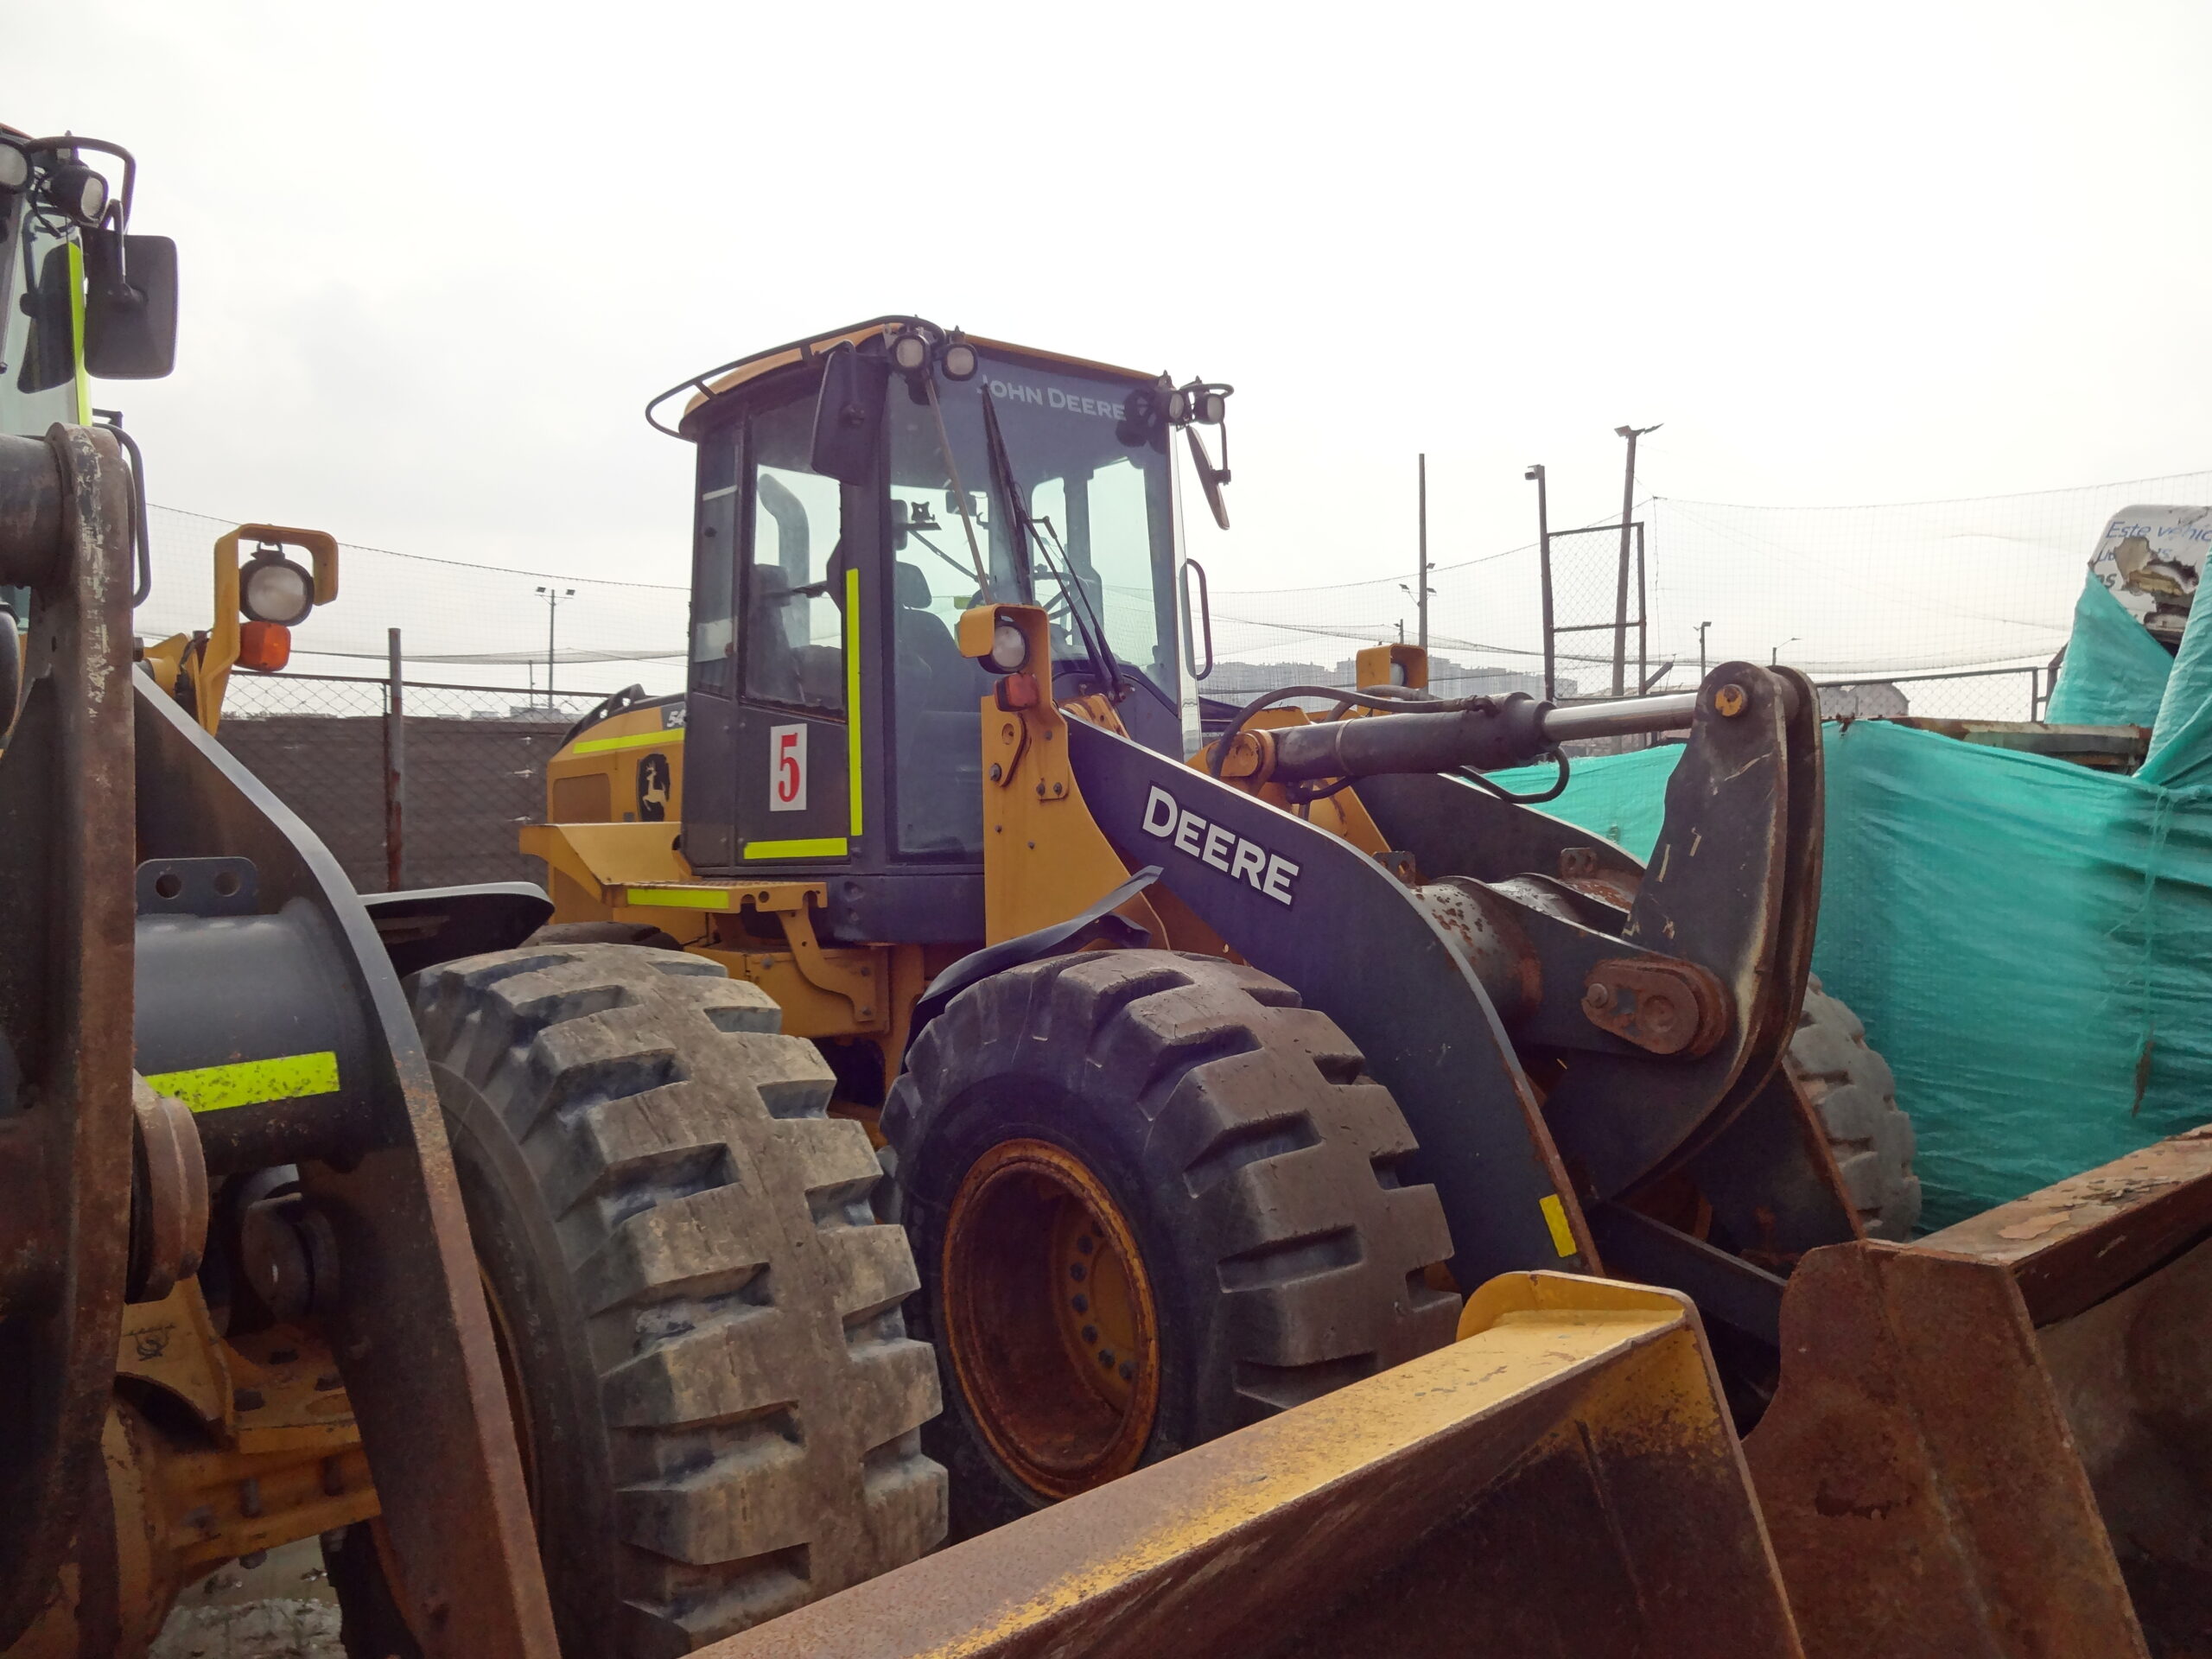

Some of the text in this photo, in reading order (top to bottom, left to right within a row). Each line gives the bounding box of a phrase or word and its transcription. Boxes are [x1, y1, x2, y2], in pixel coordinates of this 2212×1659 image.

[1047, 387, 1127, 421] DEERE
[2106, 521, 2152, 538] Este
[779, 733, 800, 803] 5
[1142, 785, 1300, 906] DEERE
